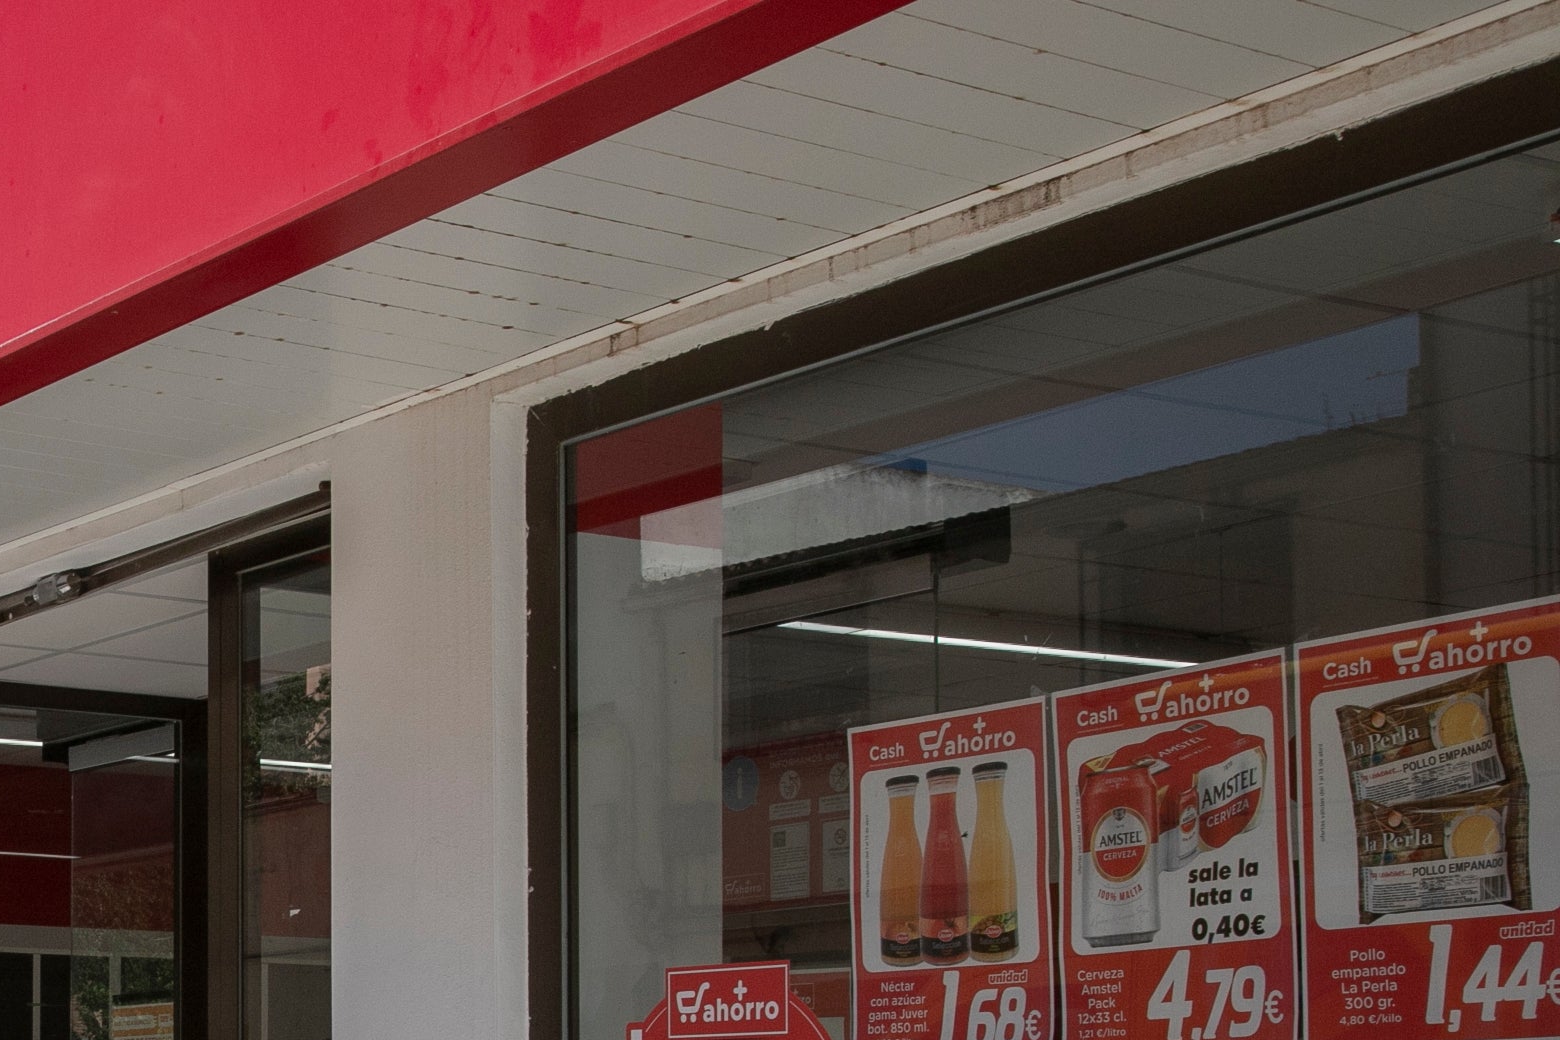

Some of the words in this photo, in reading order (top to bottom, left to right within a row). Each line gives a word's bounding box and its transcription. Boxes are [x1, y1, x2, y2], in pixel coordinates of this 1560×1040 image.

[1322, 657, 1372, 680] Cash
[1429, 636, 1533, 670] ahorro
[1077, 705, 1118, 727] Cash
[1165, 687, 1250, 718] ahorro
[869, 743, 905, 761] Cash
[944, 730, 1016, 756] ahorro
[1158, 735, 1207, 758] AMSTEL
[1369, 725, 1420, 754] Perla
[1403, 756, 1437, 773] POLLO
[1440, 739, 1493, 763] EMPANADO
[1201, 768, 1258, 810] AMSTEL
[1205, 798, 1250, 828] CERVEZA
[1099, 831, 1143, 848] AMSTEL
[1382, 829, 1433, 852] Perla
[1103, 850, 1137, 861] CERVEZA
[1188, 861, 1231, 884] sale
[1238, 858, 1259, 878] la
[1412, 864, 1446, 878] POLLO
[1448, 857, 1504, 873] EMPANADO
[1119, 884, 1143, 901] MALTA
[1189, 888, 1232, 908] lata
[1240, 888, 1253, 902] a
[1191, 913, 1266, 944] 0,40€
[1499, 919, 1556, 940] unidad
[1350, 949, 1386, 962] Pollo
[988, 969, 1029, 984] unidad
[1077, 969, 1125, 981] Cerveza
[1331, 963, 1407, 980] empanado
[881, 981, 915, 993] Néctar
[1081, 982, 1122, 995] Amstel
[1341, 982, 1358, 995] La
[1362, 980, 1398, 993] Perla
[870, 997, 885, 1007] con
[891, 994, 926, 1006] azúcar
[1087, 996, 1116, 1010] Pack
[1344, 996, 1374, 1010] 300
[1378, 997, 1396, 1010] gr.
[703, 998, 780, 1023] ahorro
[868, 1011, 897, 1023] gama
[900, 1009, 928, 1020] Juver
[1077, 1012, 1110, 1025] 12x33
[1113, 1010, 1128, 1023] cl.
[867, 1023, 888, 1035] bot.
[890, 1022, 911, 1033] 850
[914, 1021, 930, 1033] ml.
[1339, 1015, 1366, 1026] 4,80
[1368, 1013, 1403, 1025] €/kilo
[1096, 1027, 1127, 1038] €/litro
